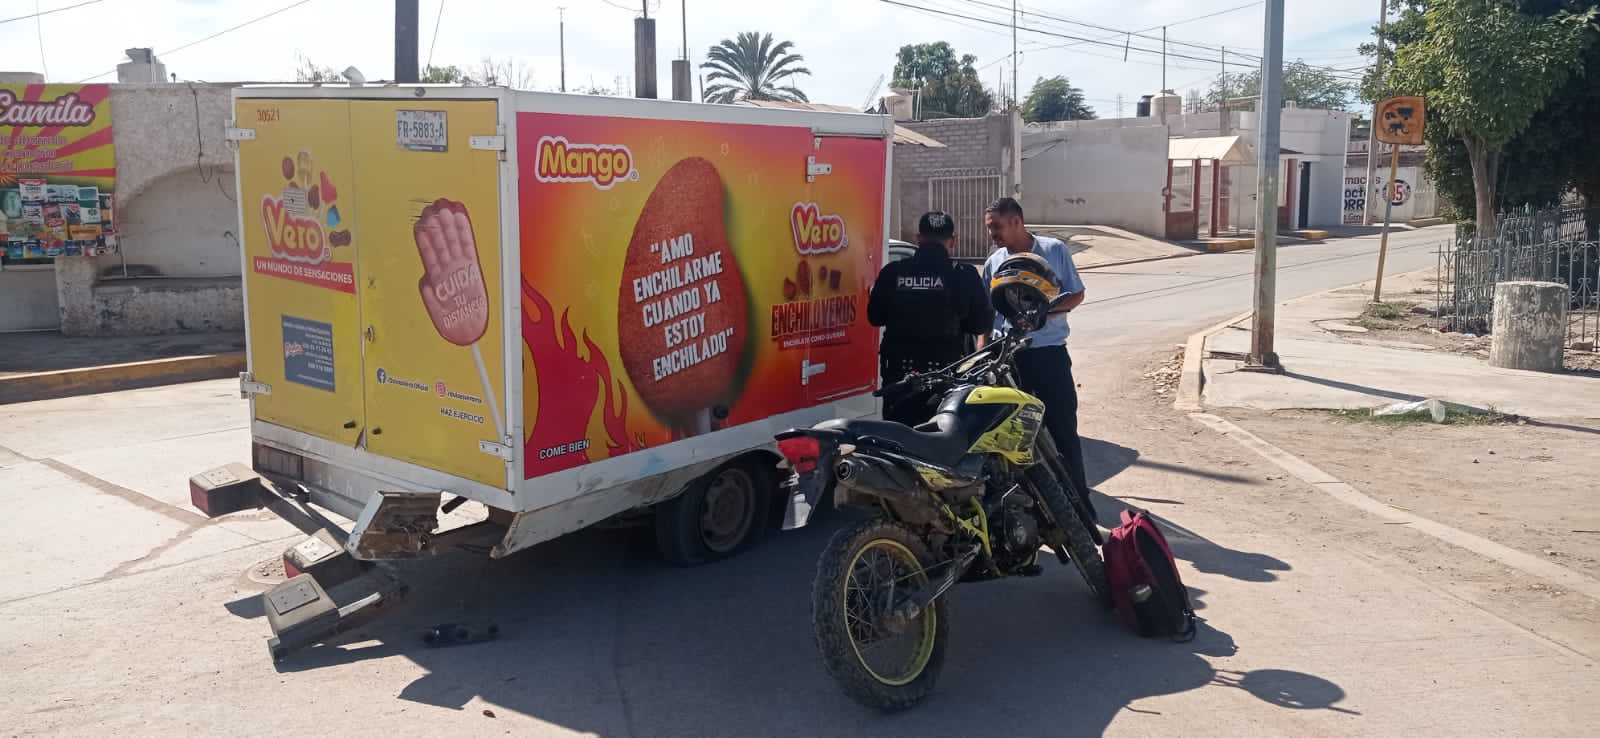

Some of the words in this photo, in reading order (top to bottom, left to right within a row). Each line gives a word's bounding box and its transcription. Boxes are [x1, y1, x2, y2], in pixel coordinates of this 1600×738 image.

[397, 120, 445, 139] FR-5883-A
[541, 143, 629, 180] Mango
[264, 201, 323, 252] Vero
[797, 210, 841, 245] Vero
[651, 232, 694, 263] "AMO
[256, 260, 267, 270] UN
[268, 262, 293, 275] MUNDO
[294, 266, 303, 276] DE
[304, 268, 353, 283] SENSACIONES
[435, 263, 479, 301] CUIDA
[633, 252, 723, 302] ENCHILARME
[897, 276, 944, 288] POLICIA
[454, 294, 466, 307] TU
[642, 287, 701, 327] CUANDO
[703, 280, 722, 304] YA
[665, 313, 706, 348] ESTOY
[652, 328, 734, 381] ENCHILADO"
[440, 407, 452, 417] HAZ
[453, 410, 484, 424] EJERCICIO
[540, 445, 567, 459] COME
[568, 441, 590, 453] BIEN
